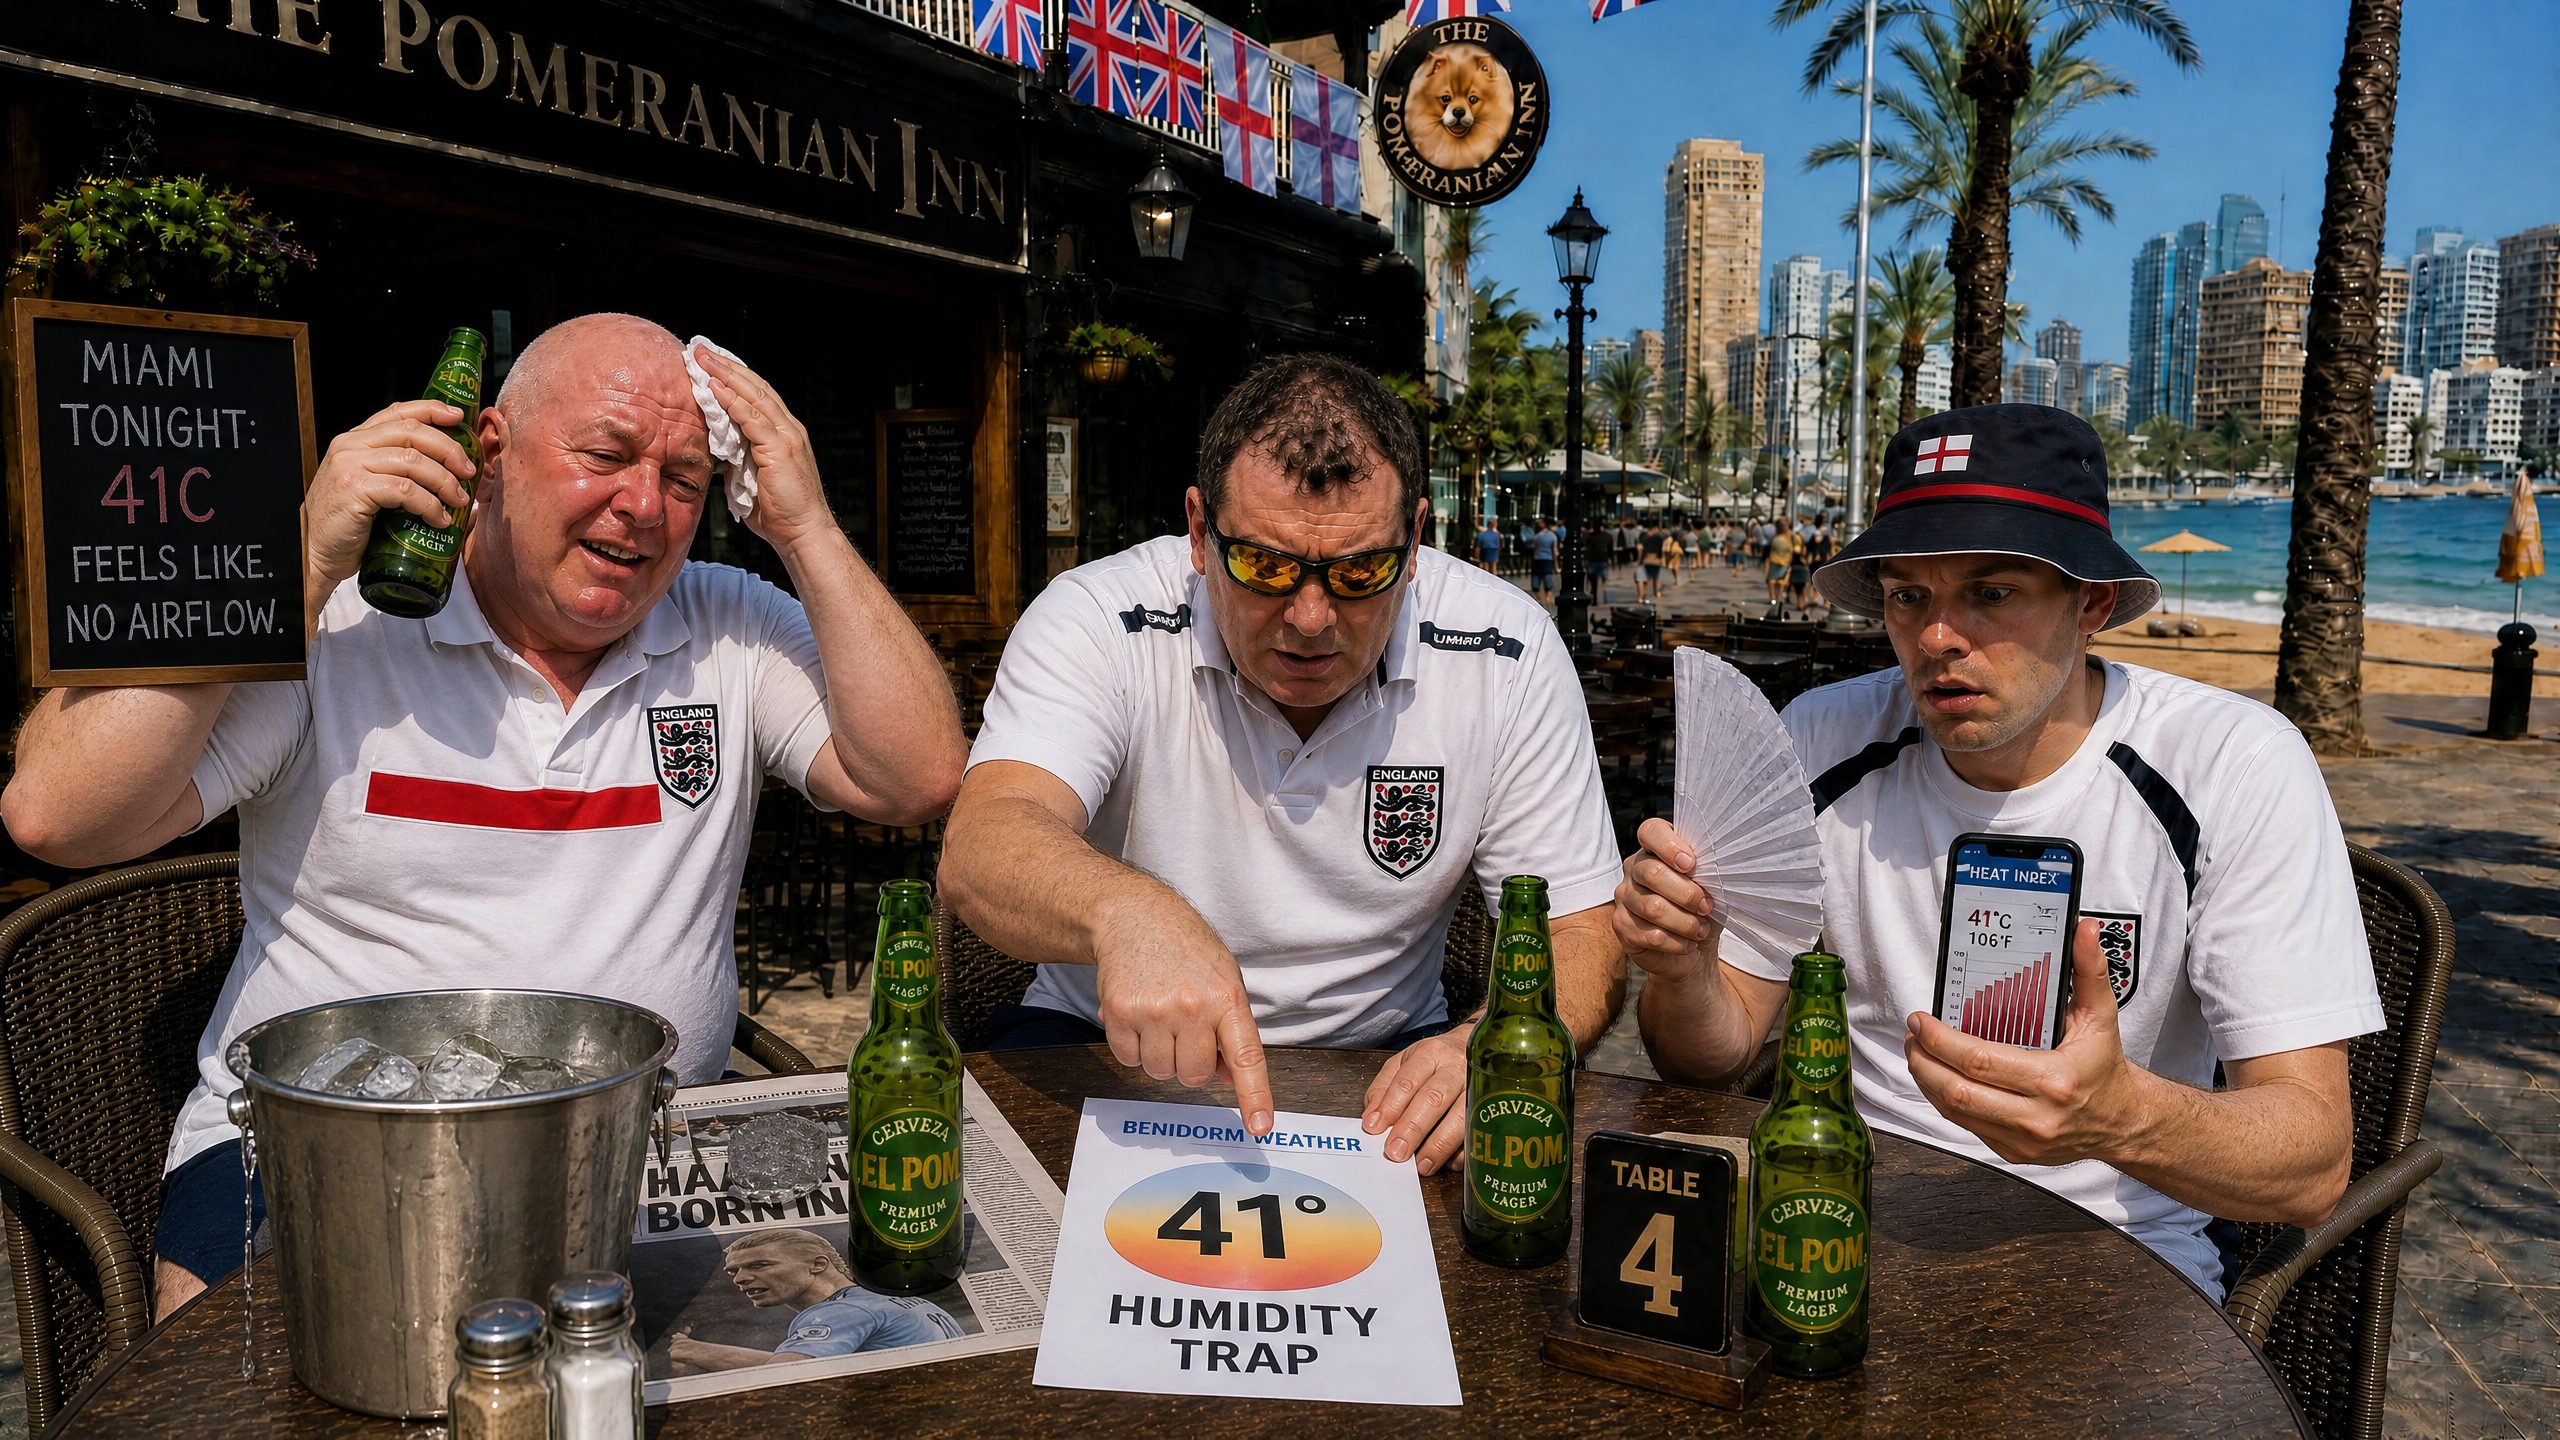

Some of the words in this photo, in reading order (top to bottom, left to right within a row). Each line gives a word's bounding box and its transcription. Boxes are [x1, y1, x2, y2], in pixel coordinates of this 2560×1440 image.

[1432, 22, 1490, 45] THE
[379, 0, 878, 192] POMERANIAN
[1515, 81, 1537, 139] INN
[83, 339, 213, 389] MIAMI
[60, 403, 256, 448] TONIGHT:
[101, 465, 215, 524] 41C
[72, 545, 178, 583] FEELS
[193, 544, 274, 579] LIKE.
[66, 603, 116, 643] NO
[128, 598, 283, 641] AIRFLOW.
[652, 707, 714, 721] ENGLAND
[1372, 769, 1439, 782] ENGLAND
[1970, 866, 2009, 882] HEAT
[872, 1117, 950, 1145] CERVEZA
[1479, 1100, 1553, 1128] CERVEZA
[1122, 1119, 1245, 1143] BENIDORM
[1254, 1131, 1362, 1152] WEATHER
[1471, 1128, 1499, 1166] EL
[1503, 1133, 1564, 1169] POM
[861, 1151, 896, 1191] EL
[902, 1146, 960, 1191] POM
[1483, 1174, 1548, 1194] PREMIUM
[1611, 1160, 1700, 1199] TABLE
[647, 1195, 786, 1234] BORN
[879, 1198, 947, 1219] PREMIUM
[1492, 1192, 1537, 1208] LAGER
[1771, 1199, 1855, 1228] CERVEZA
[889, 1217, 938, 1234] LAGER
[1156, 1190, 1327, 1260] 41°
[1619, 1212, 1683, 1318] 4
[1760, 1228, 1794, 1271] EL
[1800, 1232, 1864, 1274] POM
[1777, 1280, 1848, 1301] PREMIUM
[1786, 1301, 1838, 1317] LAGER
[1108, 1293, 1378, 1338] HUMIDITY
[1170, 1338, 1320, 1376] TRAP
